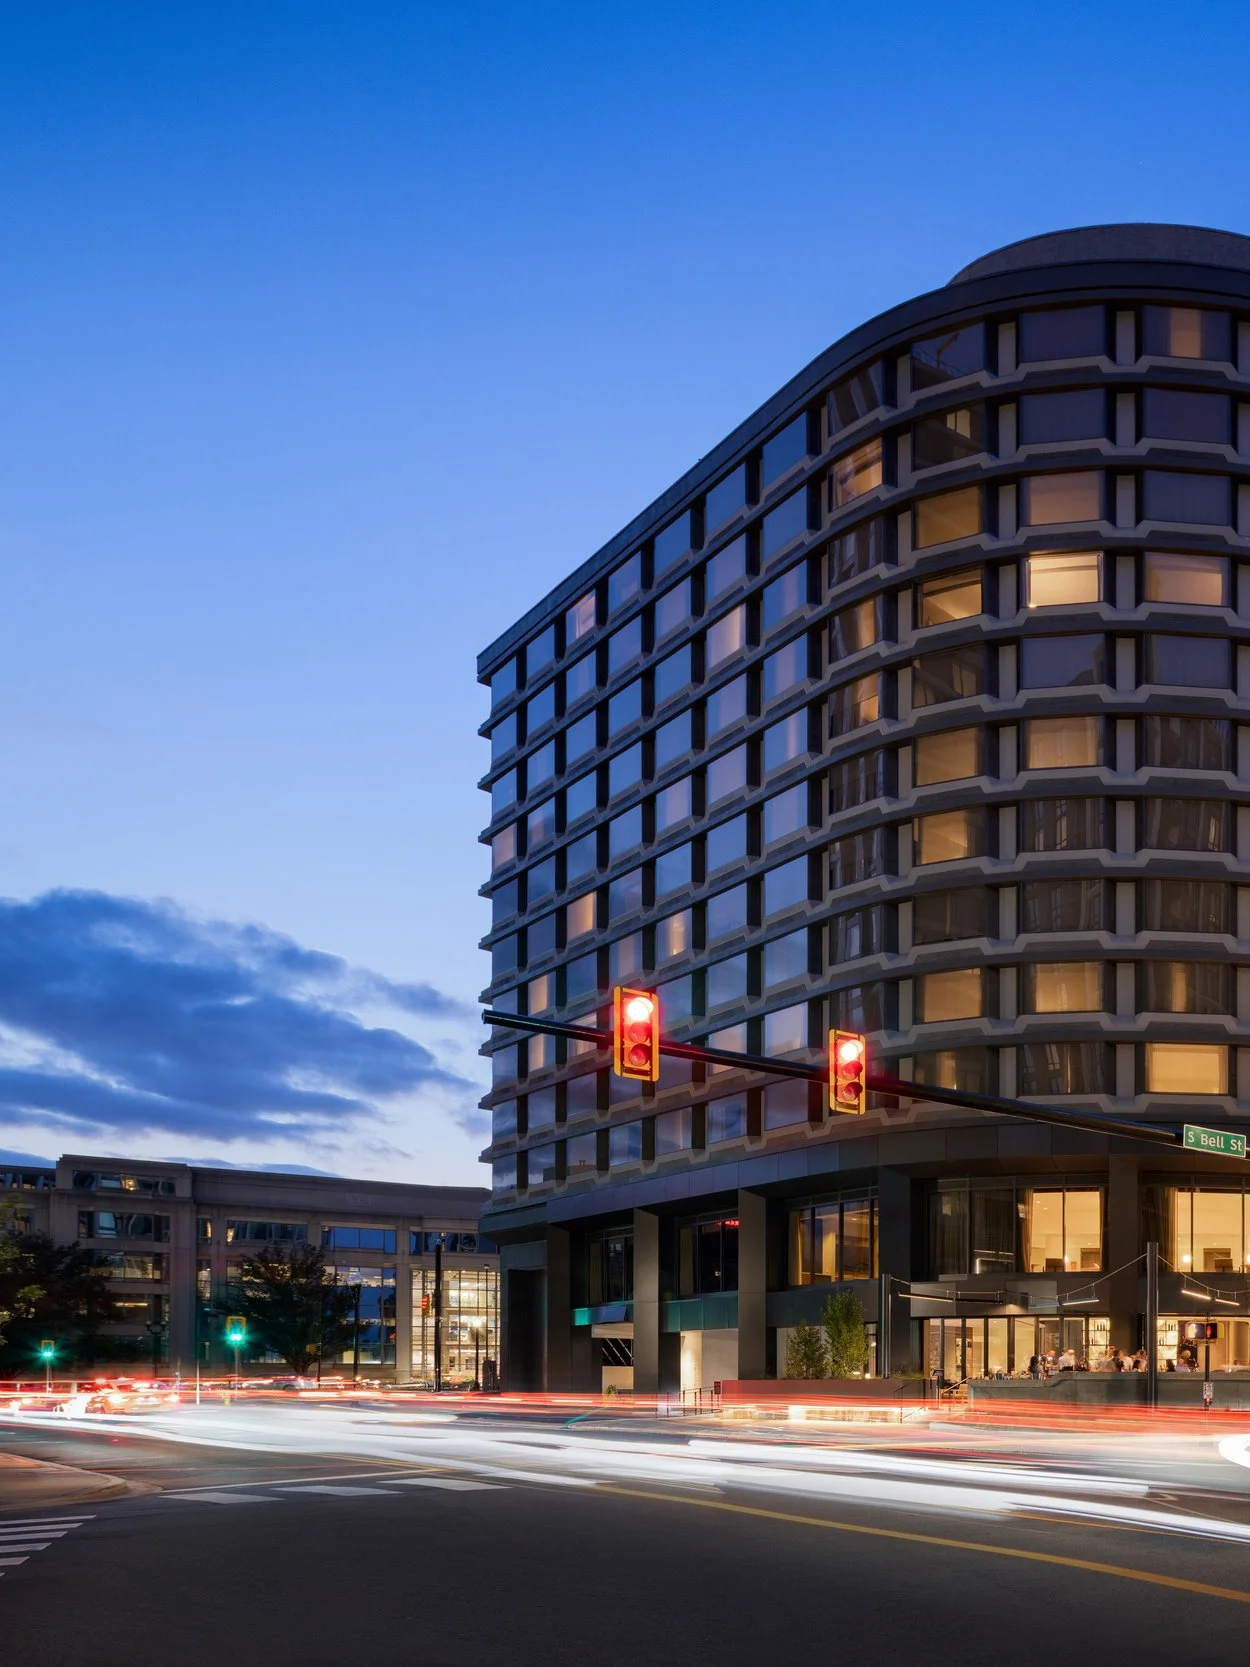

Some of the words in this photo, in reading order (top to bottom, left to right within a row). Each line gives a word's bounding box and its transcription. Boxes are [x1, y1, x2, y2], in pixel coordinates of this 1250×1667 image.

[1187, 1131, 1195, 1143] S
[1200, 1133, 1224, 1148] Bell
[1230, 1139, 1242, 1151] St
